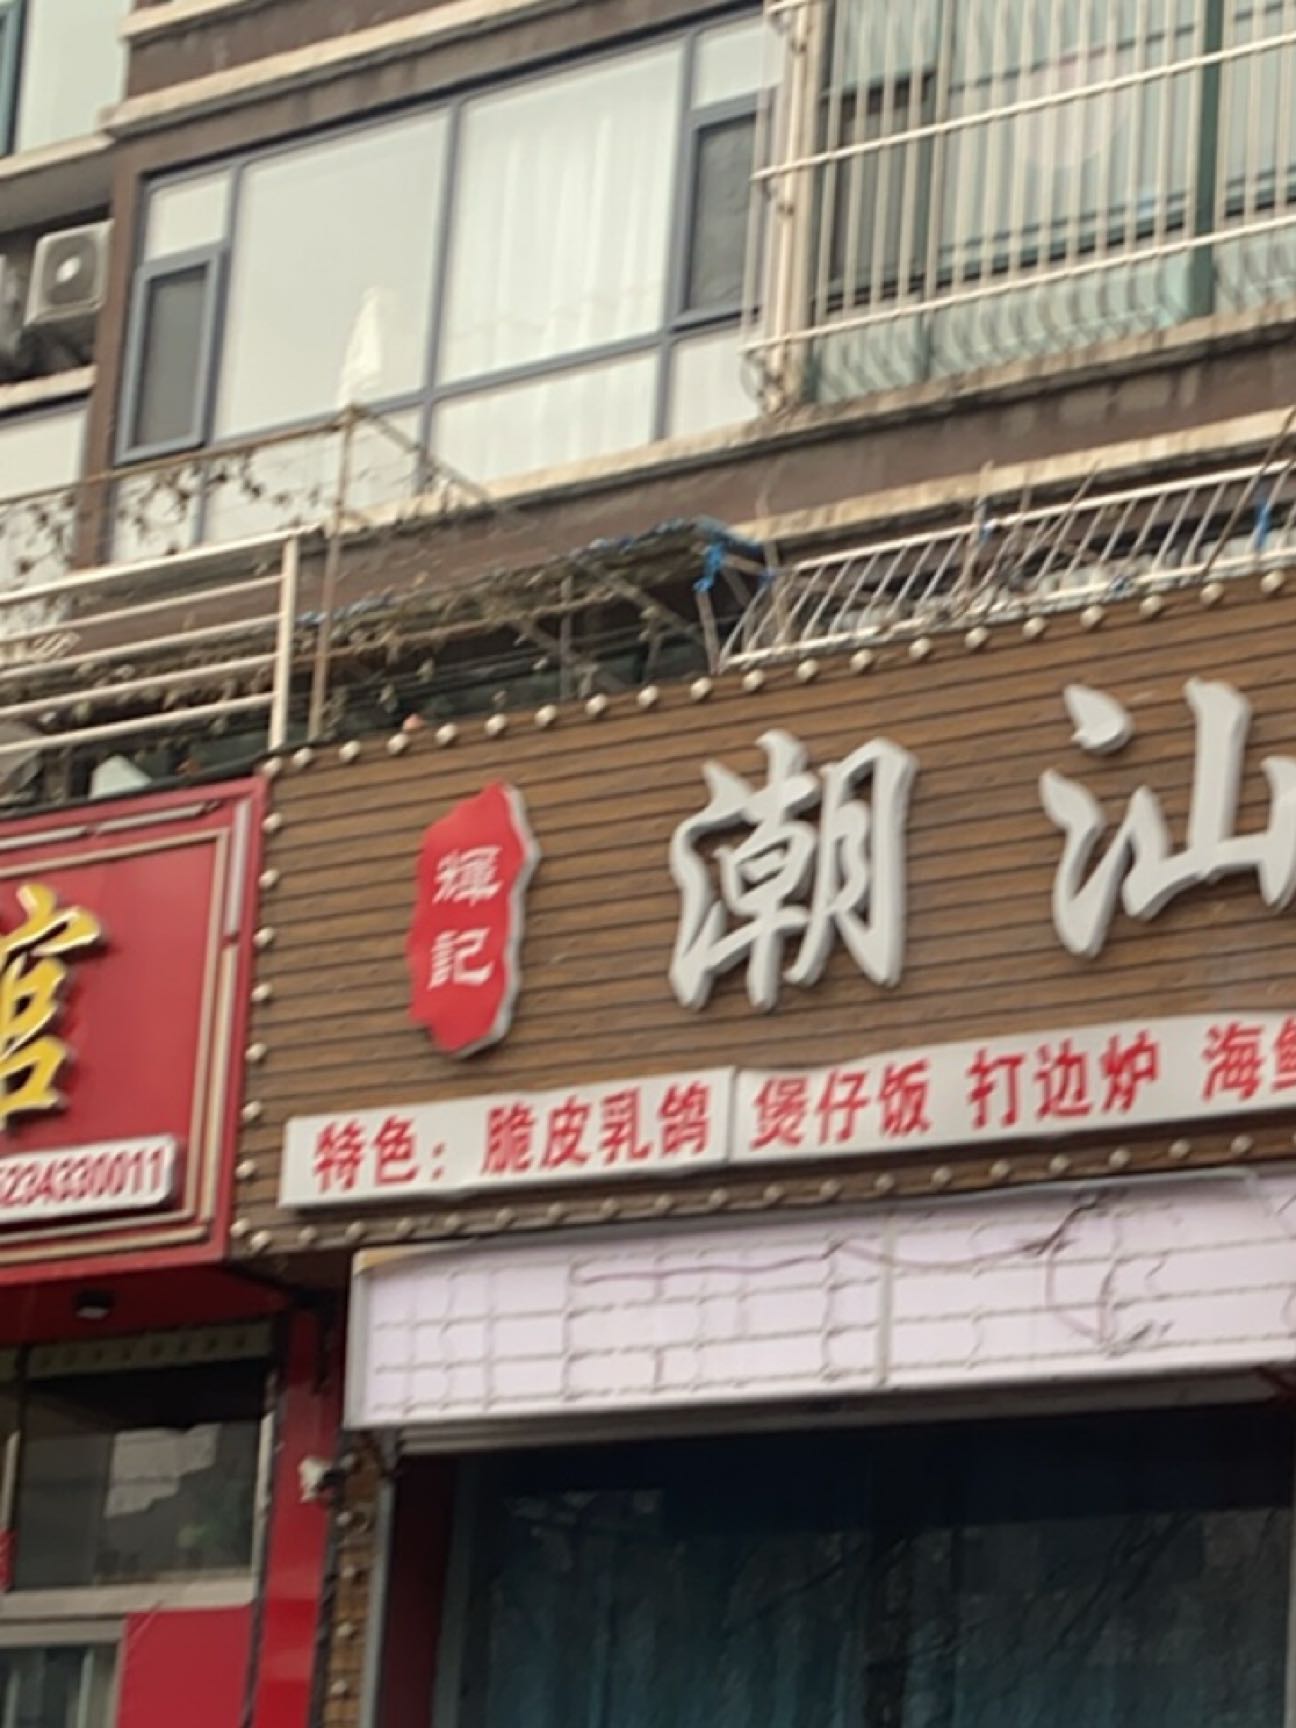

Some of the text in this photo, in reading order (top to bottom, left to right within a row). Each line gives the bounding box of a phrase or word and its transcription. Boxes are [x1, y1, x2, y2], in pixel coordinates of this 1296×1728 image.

[750, 1058, 932, 1151] 煲仔饭
[965, 1028, 1159, 1131] 打边炉
[0, 1146, 166, 1206] 234330011
